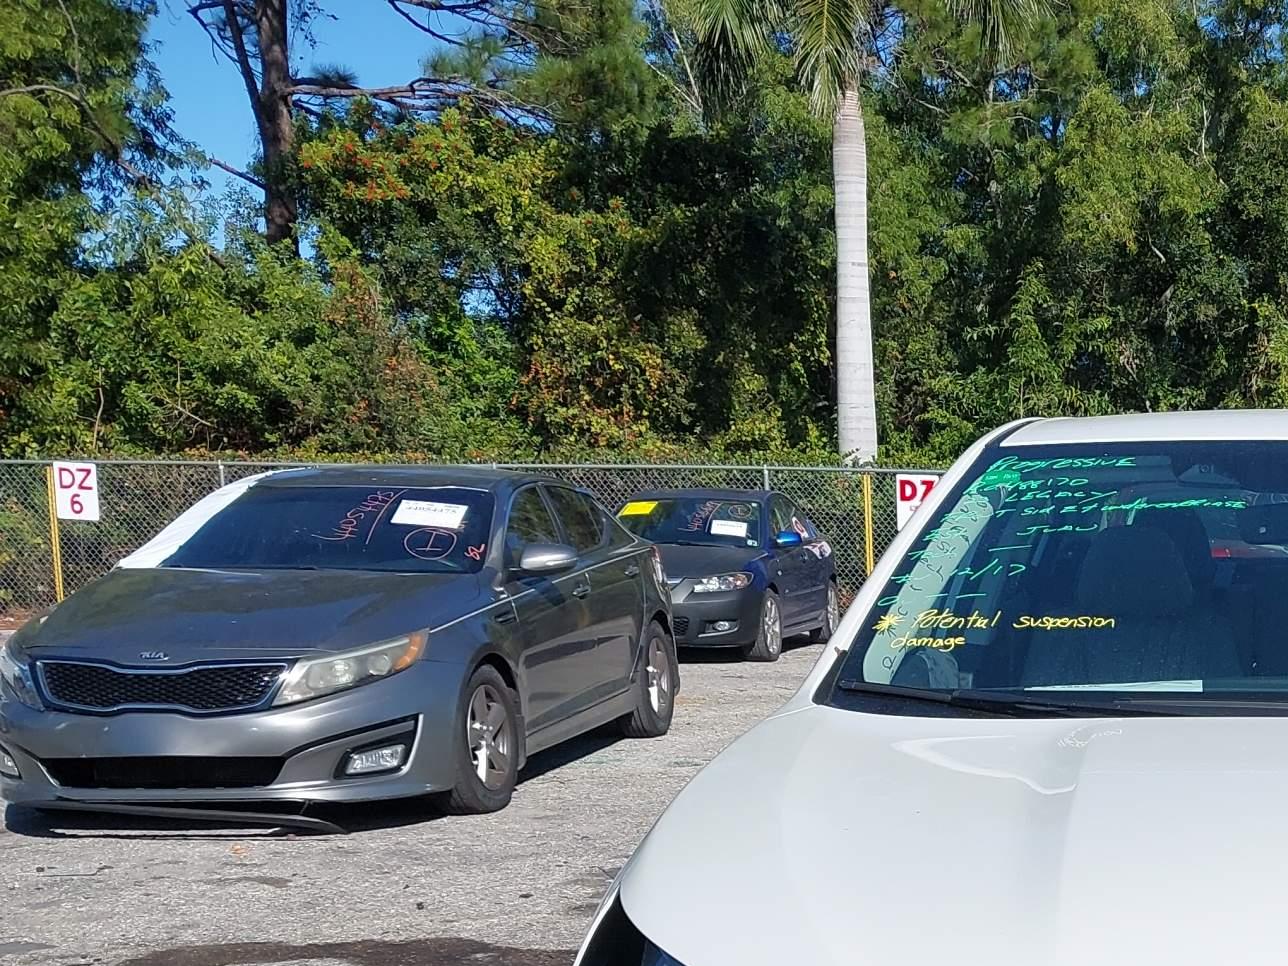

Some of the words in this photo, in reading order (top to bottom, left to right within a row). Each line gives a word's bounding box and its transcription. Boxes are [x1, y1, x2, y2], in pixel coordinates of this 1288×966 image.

[58, 467, 94, 491] DZ
[70, 493, 84, 514] 6
[911, 608, 1002, 629] Potential
[1012, 615, 1116, 631] suspension
[890, 632, 966, 652] damage
